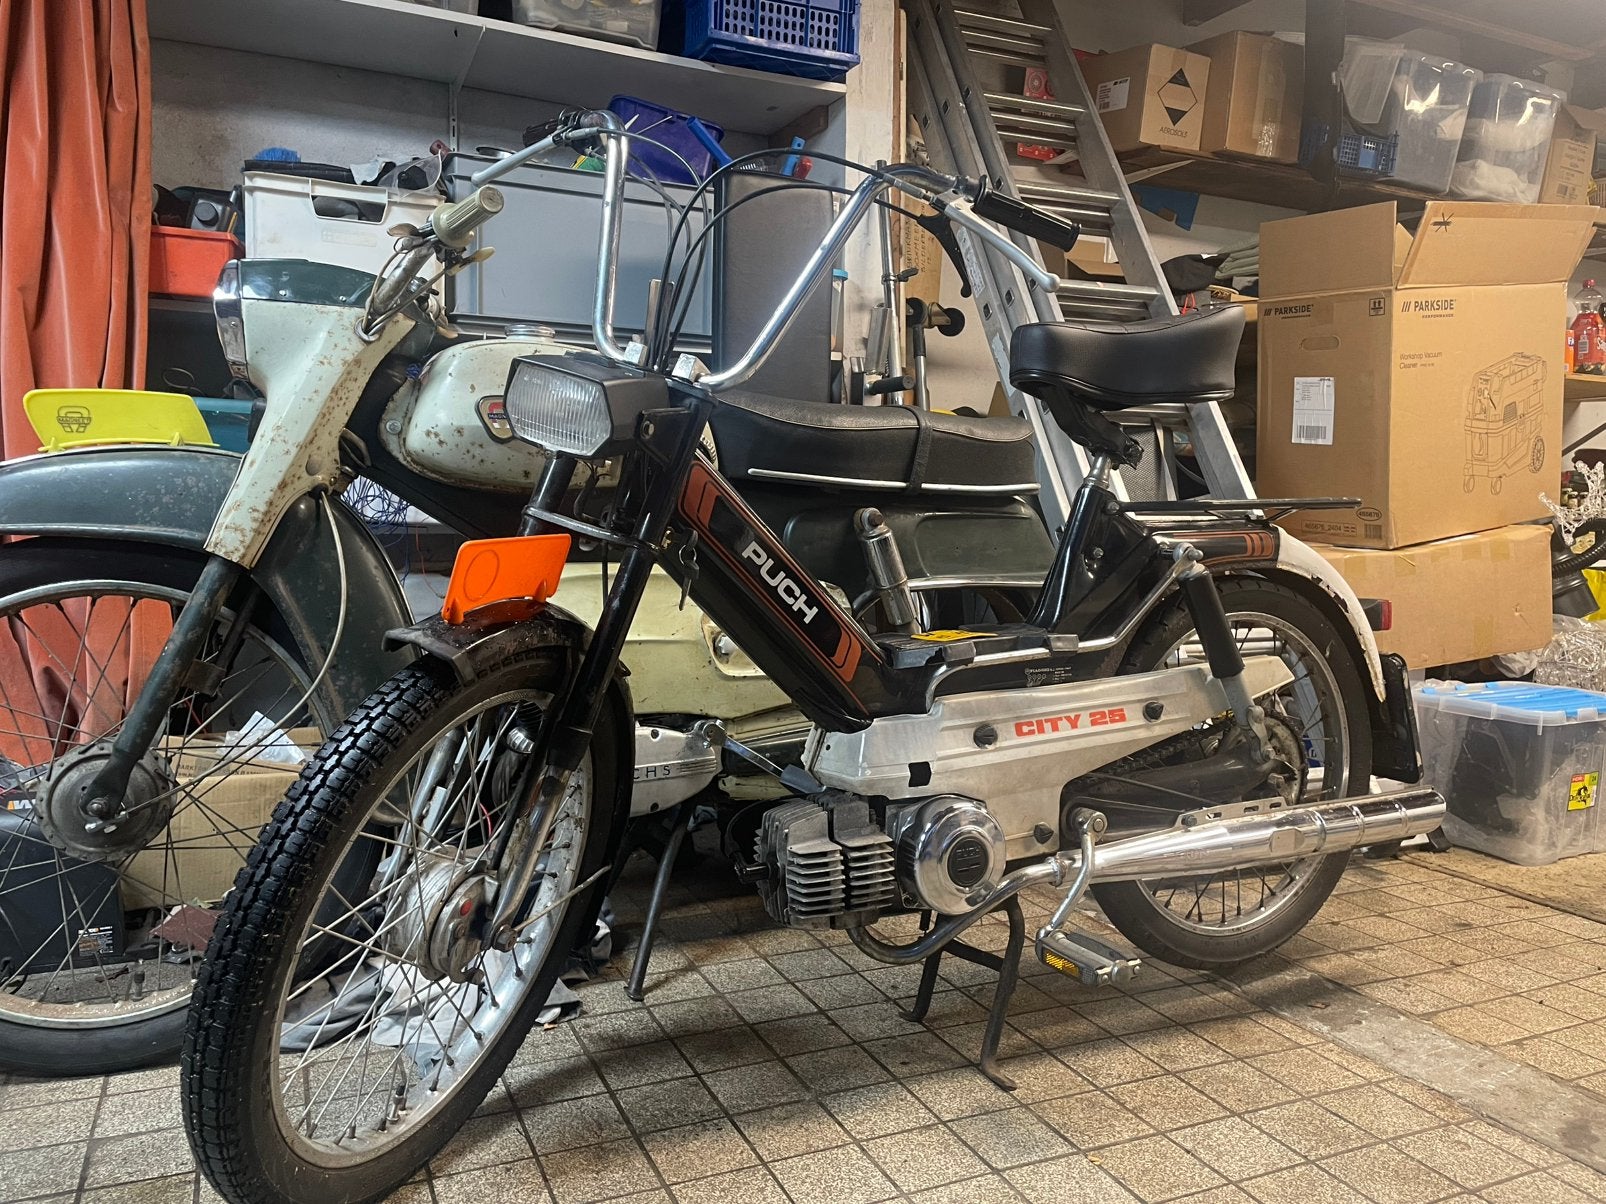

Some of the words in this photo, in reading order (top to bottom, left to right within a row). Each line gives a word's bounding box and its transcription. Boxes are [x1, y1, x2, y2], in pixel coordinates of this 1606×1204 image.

[1274, 303, 1313, 316] PARKSIDE
[1414, 299, 1456, 312] PARKSIDE
[741, 540, 819, 625] PUCH
[1014, 713, 1082, 738] CITY
[1088, 707, 1127, 727] 25
[632, 764, 672, 780] CHS
